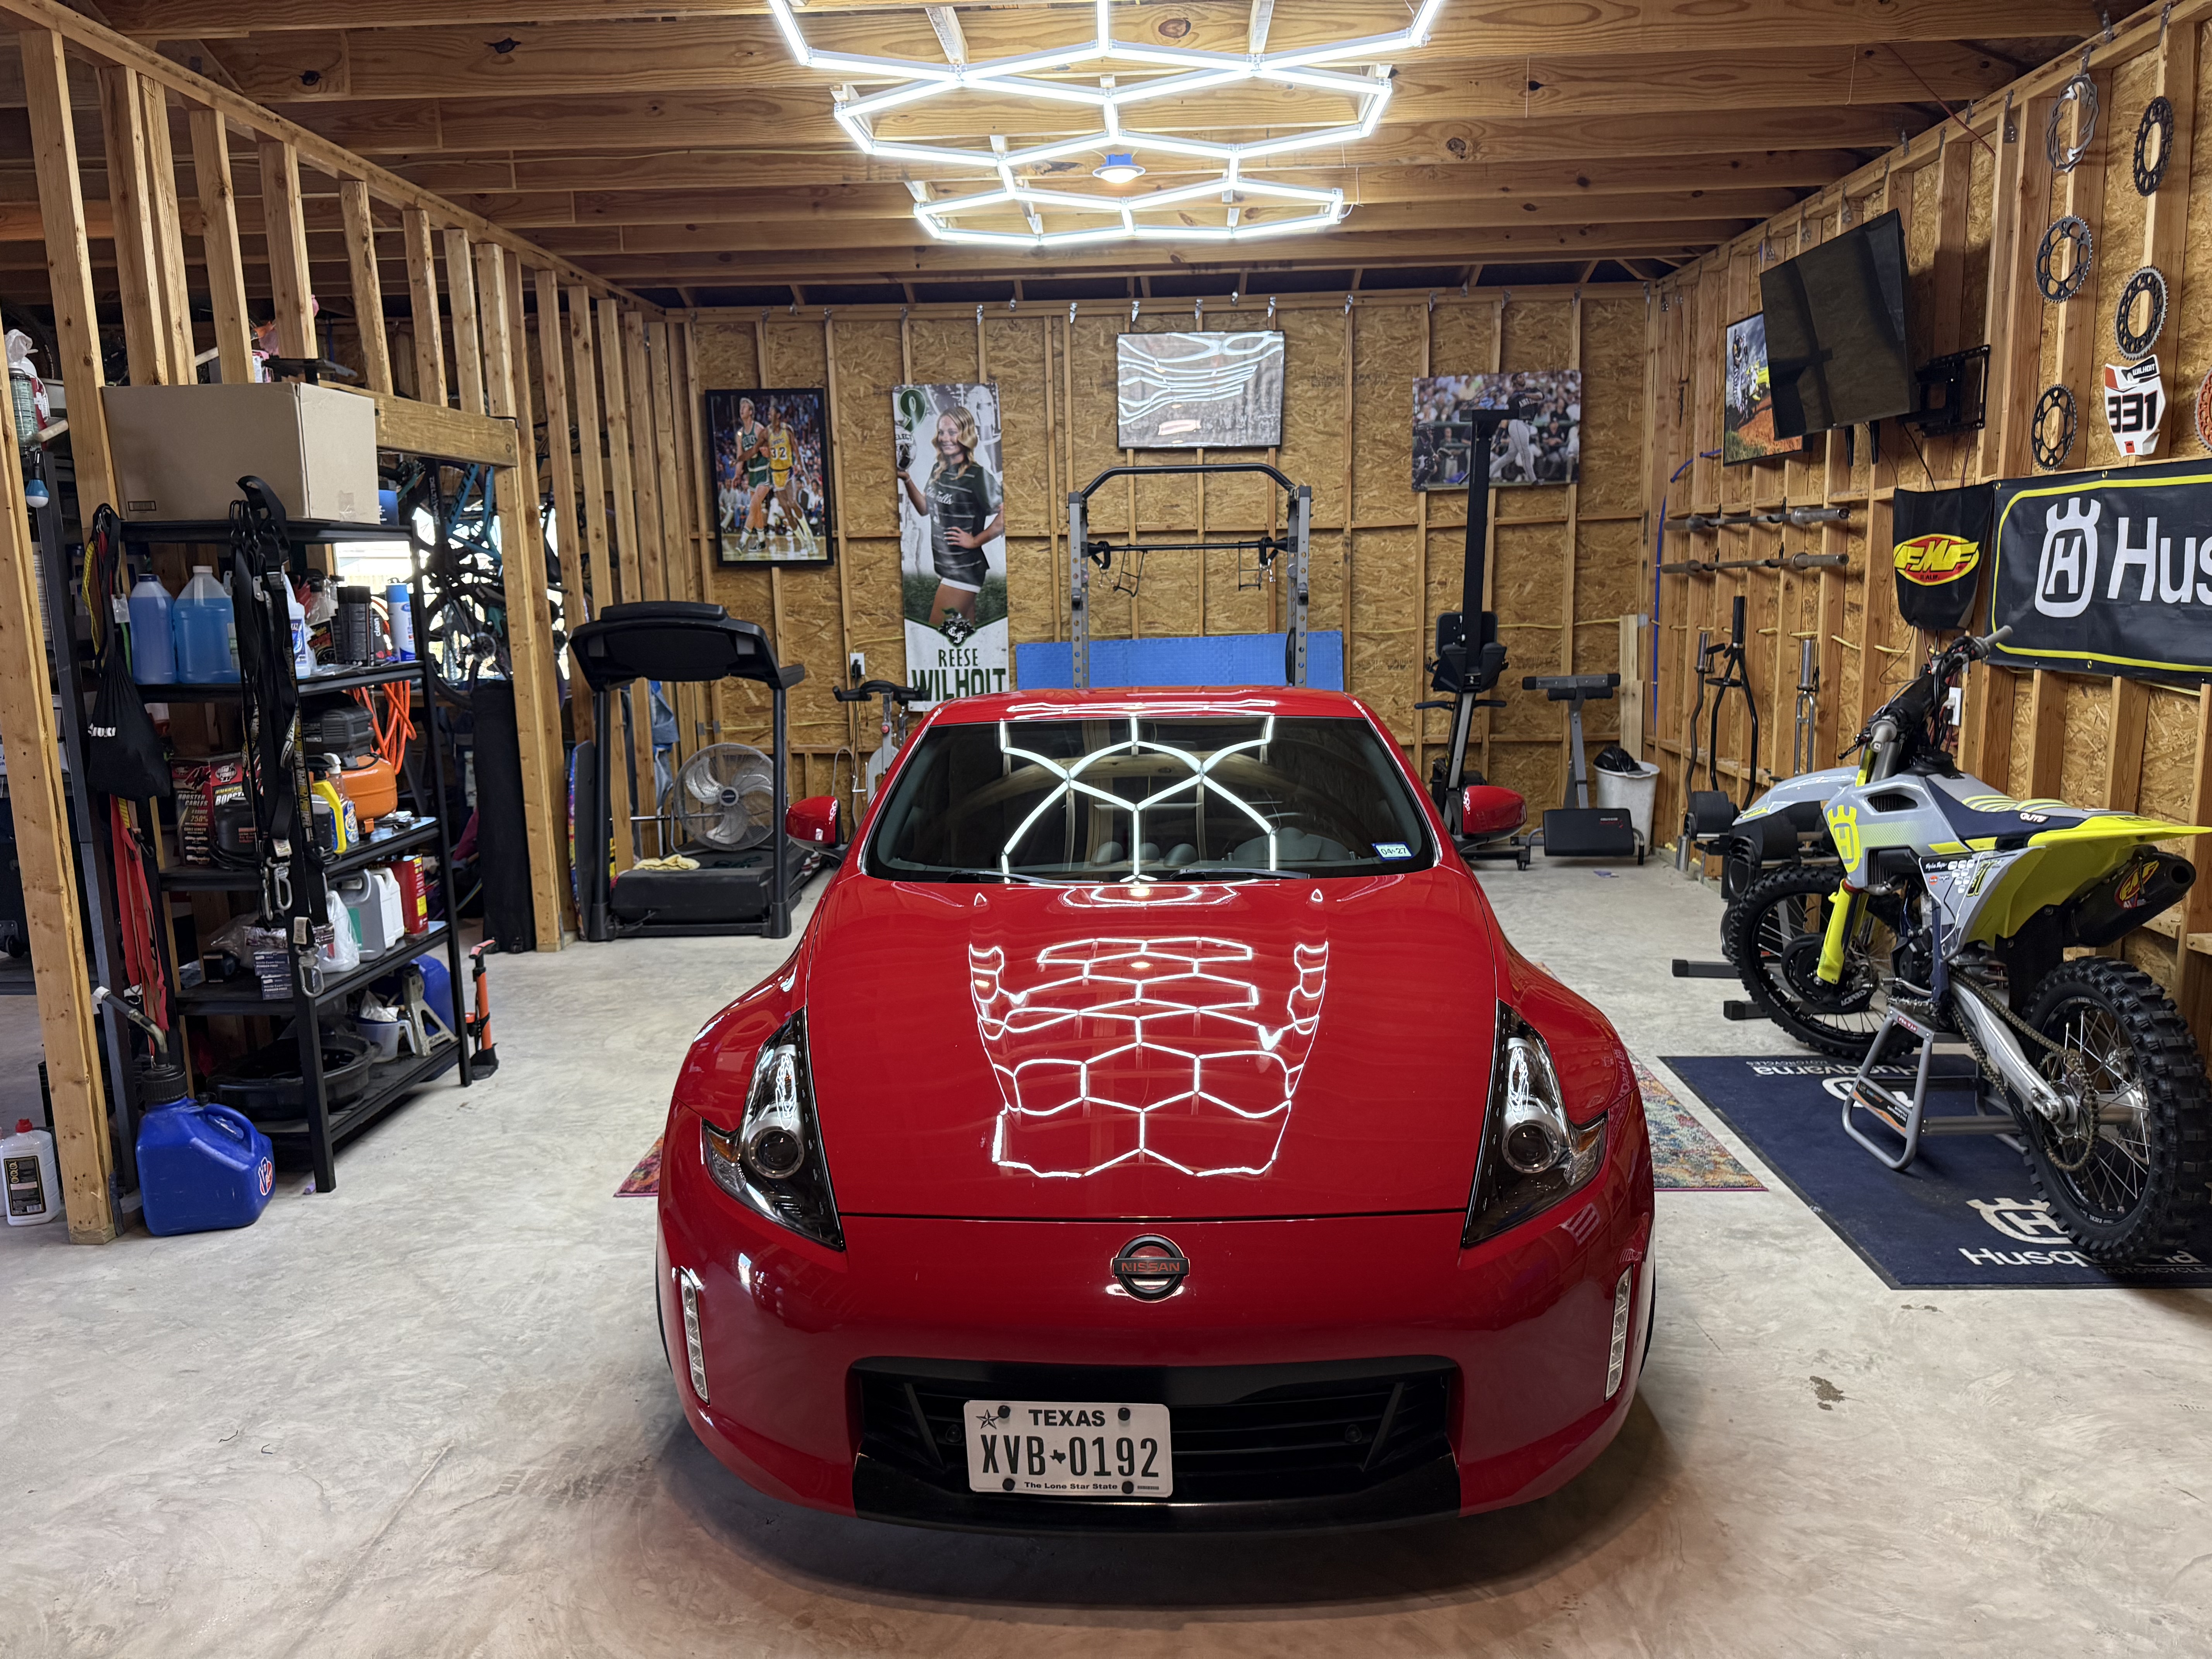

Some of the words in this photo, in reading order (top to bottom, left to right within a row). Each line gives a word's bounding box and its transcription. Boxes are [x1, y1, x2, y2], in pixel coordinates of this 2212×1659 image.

[2132, 364, 2155, 376] WILHOIT
[898, 389, 927, 433] 9
[2108, 390, 2158, 434] 331
[770, 447, 787, 460] 32
[1894, 539, 1979, 572] FMF
[938, 648, 978, 667] REESE
[912, 668, 1006, 702] WILHOIT
[215, 792, 245, 806] BOO
[2020, 812, 2046, 823] GUTS
[1121, 1262, 1180, 1272] NISSAN
[1028, 1409, 1106, 1427] TEXAS
[981, 1434, 1046, 1475] XVB
[1068, 1436, 1159, 1477] 0192
